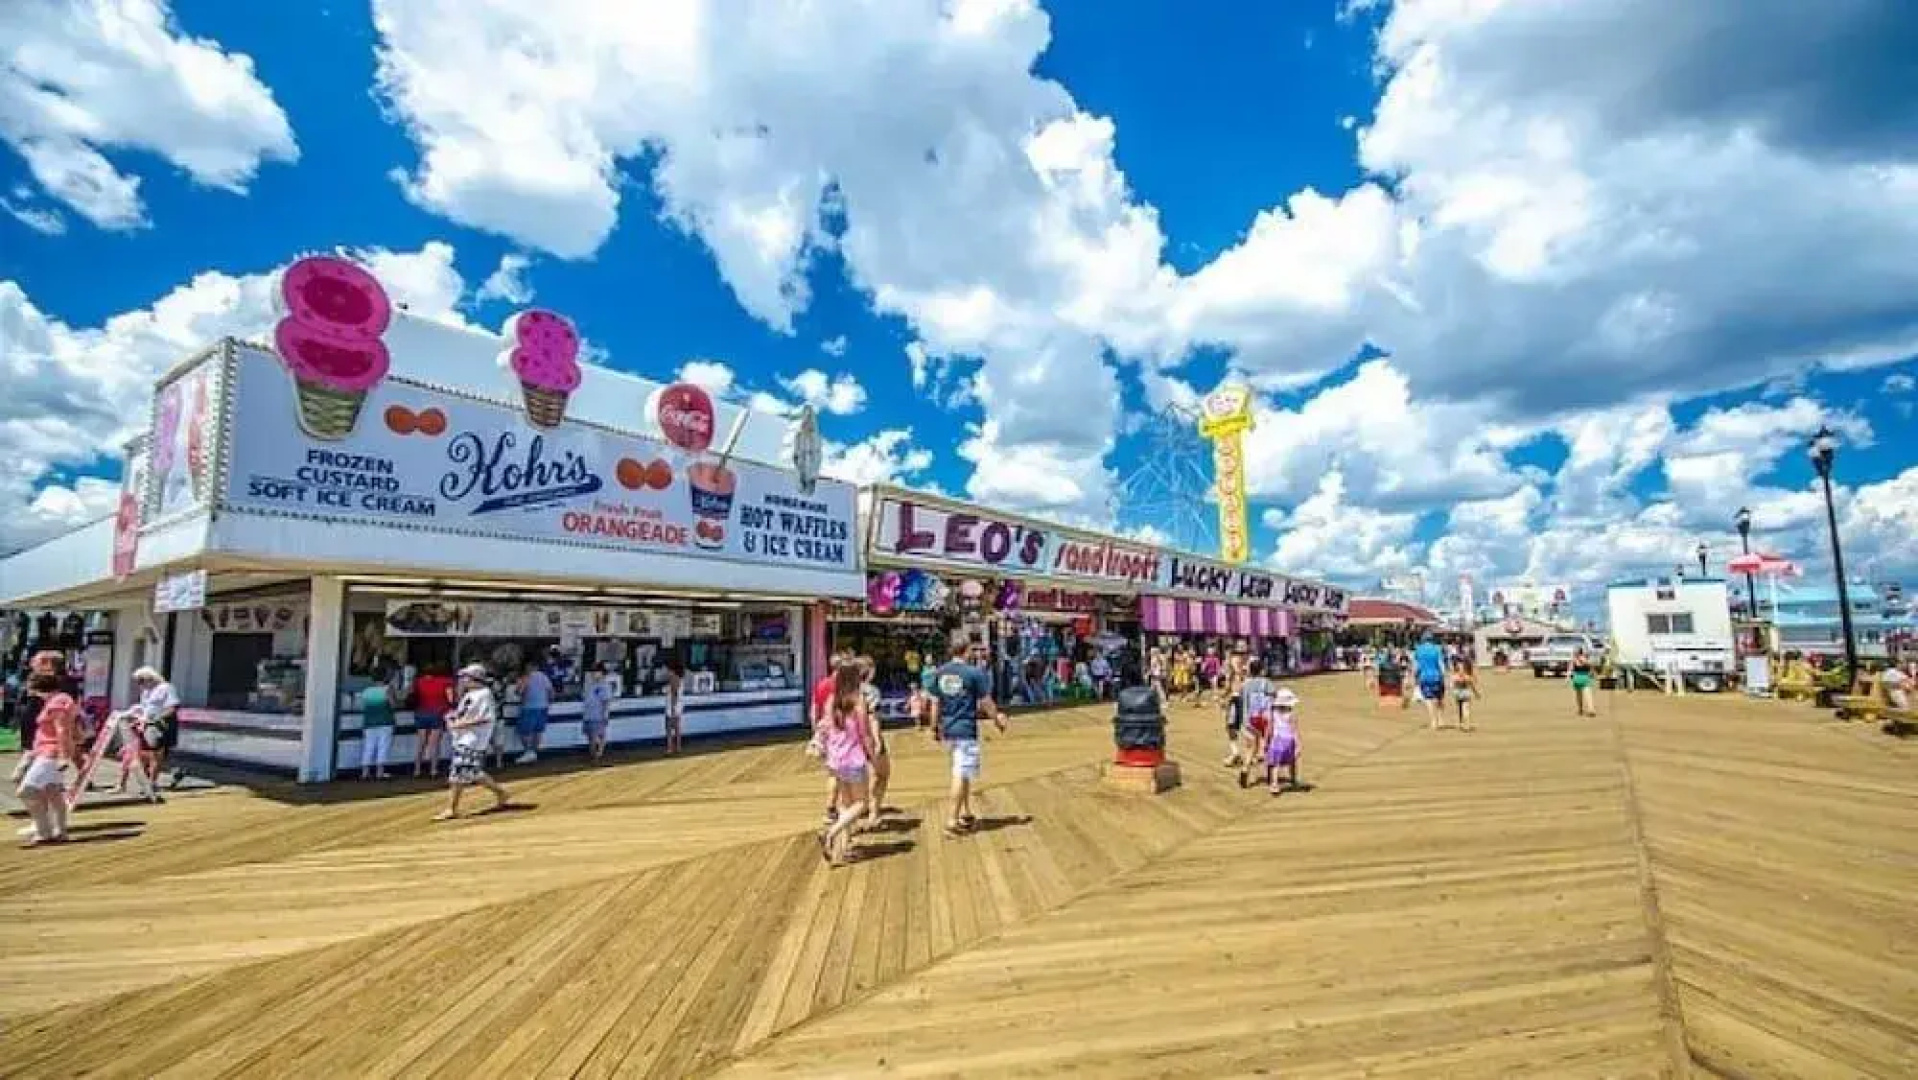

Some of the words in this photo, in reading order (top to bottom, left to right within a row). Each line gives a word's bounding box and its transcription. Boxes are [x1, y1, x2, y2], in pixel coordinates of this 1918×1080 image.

[296, 466, 400, 493] CUSTARD
[306, 449, 393, 474] FROZEN
[440, 432, 590, 501] Kohr's
[247, 481, 308, 502] SOFT
[317, 489, 351, 508] ICE
[361, 493, 436, 517] CREAM
[563, 510, 688, 546] ORANGEADE
[740, 503, 774, 530] HOT
[779, 512, 848, 541] WAFFLES
[895, 501, 1044, 565] LEO'S
[763, 533, 789, 557] ICE
[793, 538, 845, 563] CREAM
[1171, 557, 1233, 594] LUCKY
